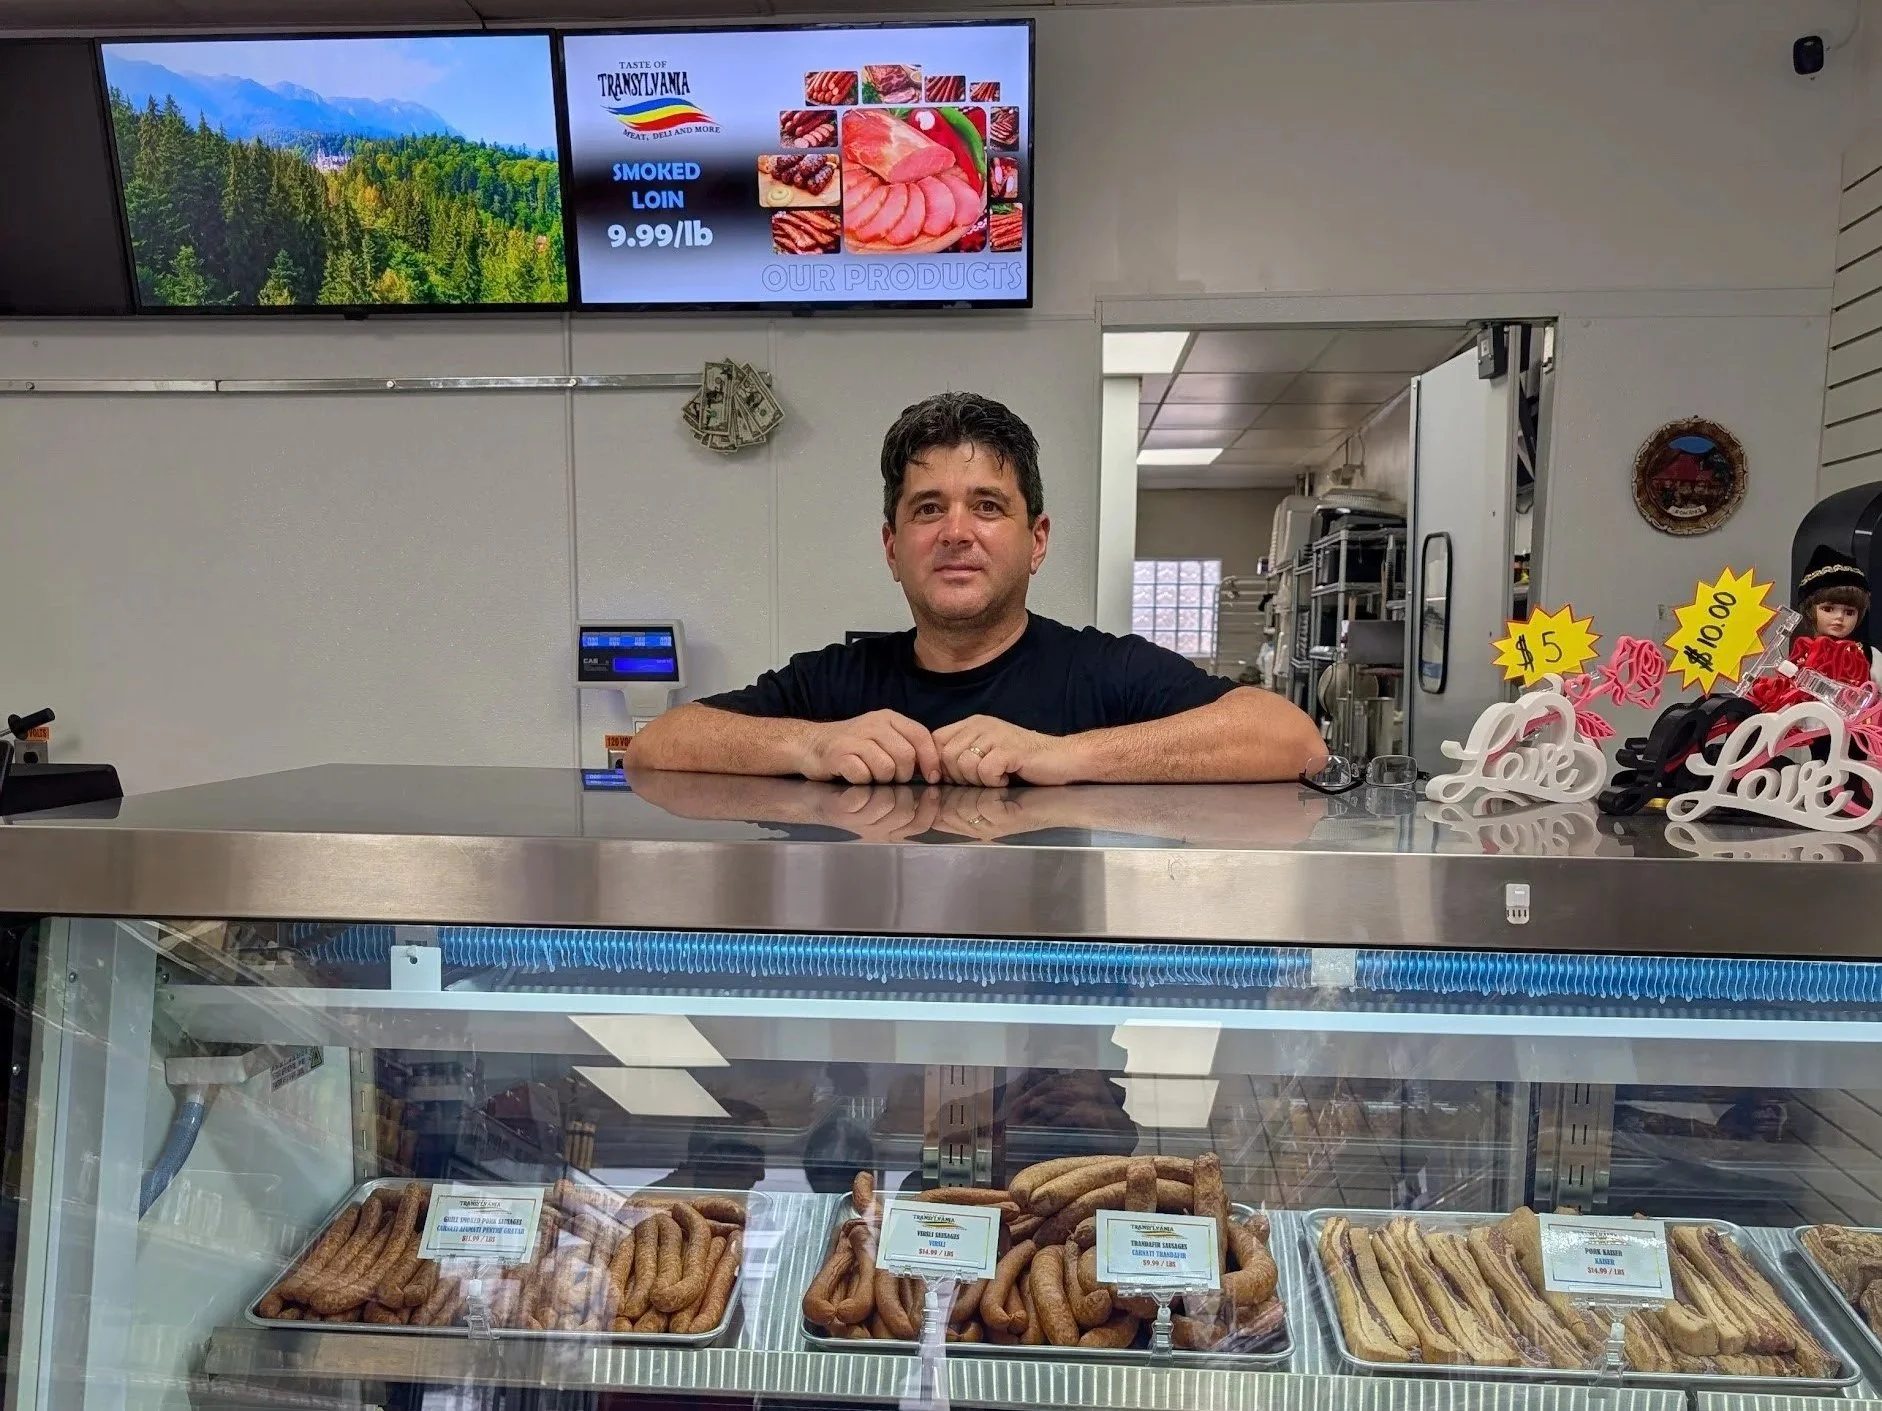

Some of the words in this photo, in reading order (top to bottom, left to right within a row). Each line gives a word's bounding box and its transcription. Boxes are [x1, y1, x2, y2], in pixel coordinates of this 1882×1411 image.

[619, 61, 651, 69] TASTE
[598, 71, 690, 101] TRANSYLVANIA
[653, 130, 672, 140] DELI
[674, 126, 693, 136] AND
[695, 126, 721, 134] MORE
[612, 162, 701, 182] SMOKED
[632, 190, 684, 209] LOIN
[607, 219, 713, 248] 9.99/lb
[761, 264, 836, 292] OUR
[843, 261, 1022, 291] PRODUCTS
[1684, 590, 1737, 673] $10.00
